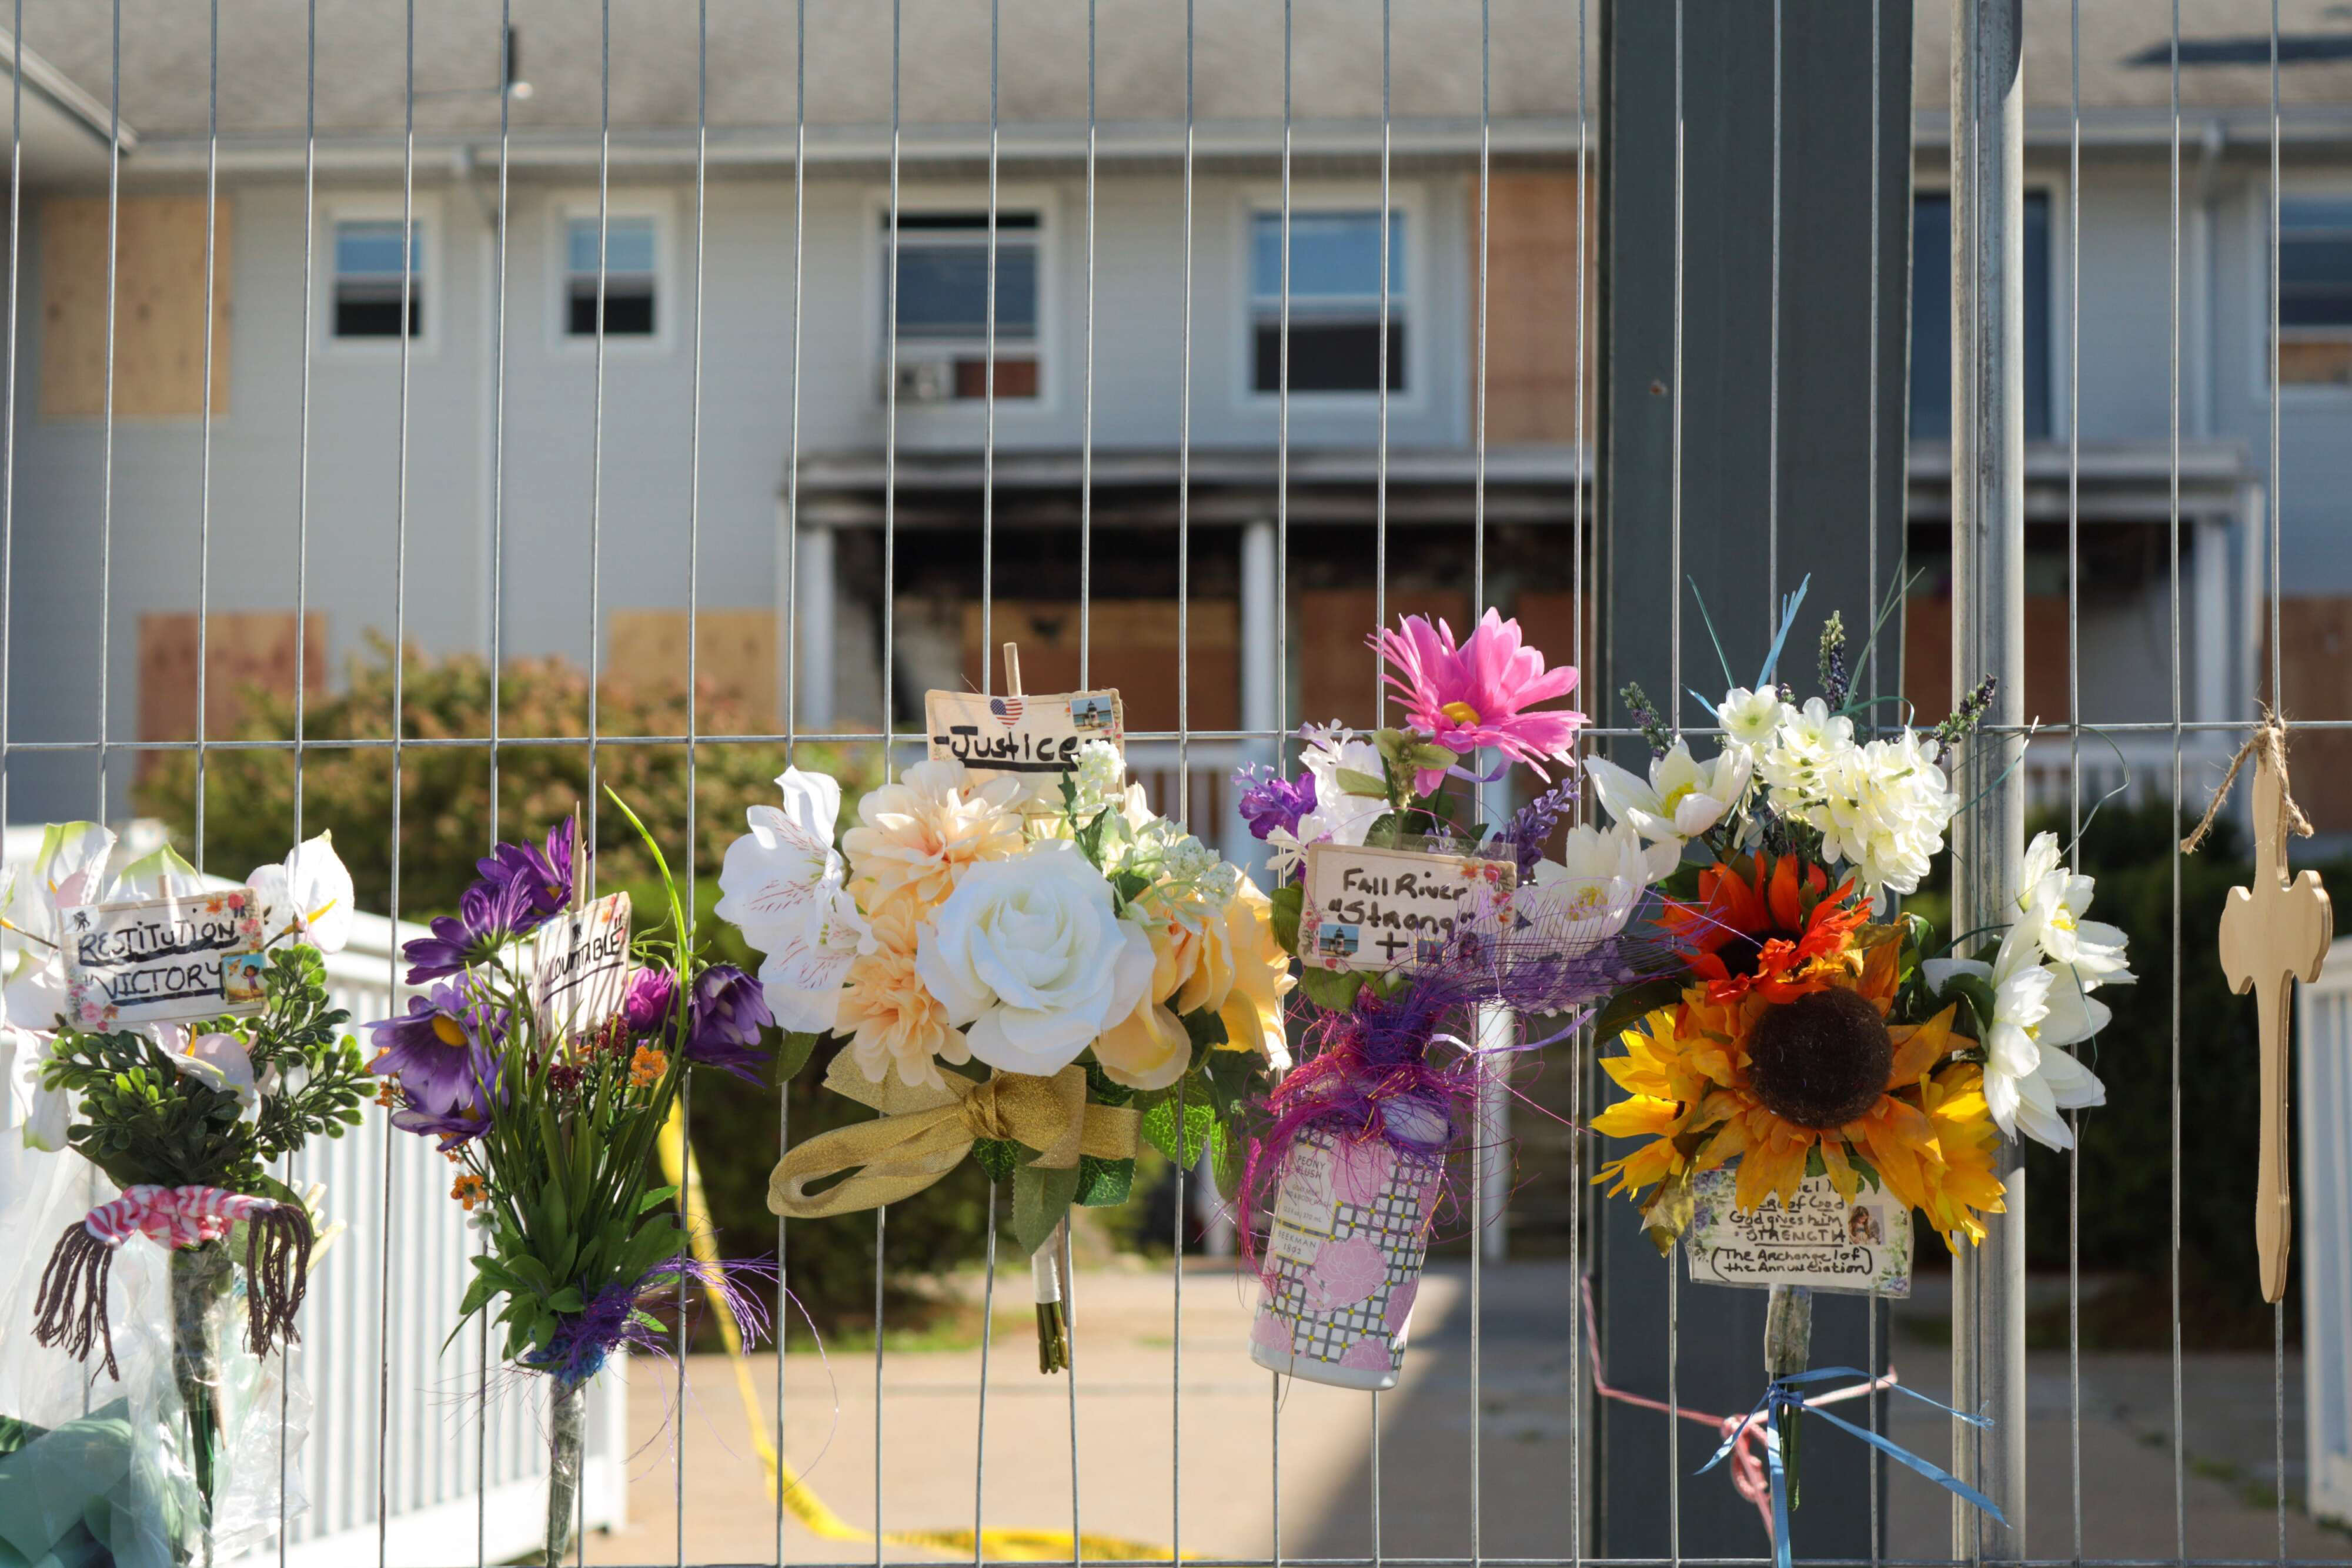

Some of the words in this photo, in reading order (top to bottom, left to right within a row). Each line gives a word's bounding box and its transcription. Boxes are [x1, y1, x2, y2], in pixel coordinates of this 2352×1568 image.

[1342, 867, 1388, 896] Fall
[1395, 871, 1468, 901] River
[1298, 1155, 1326, 1170] PEONY
[1278, 1230, 1317, 1248] BEEKMAN
[1284, 1243, 1302, 1255] 1802
